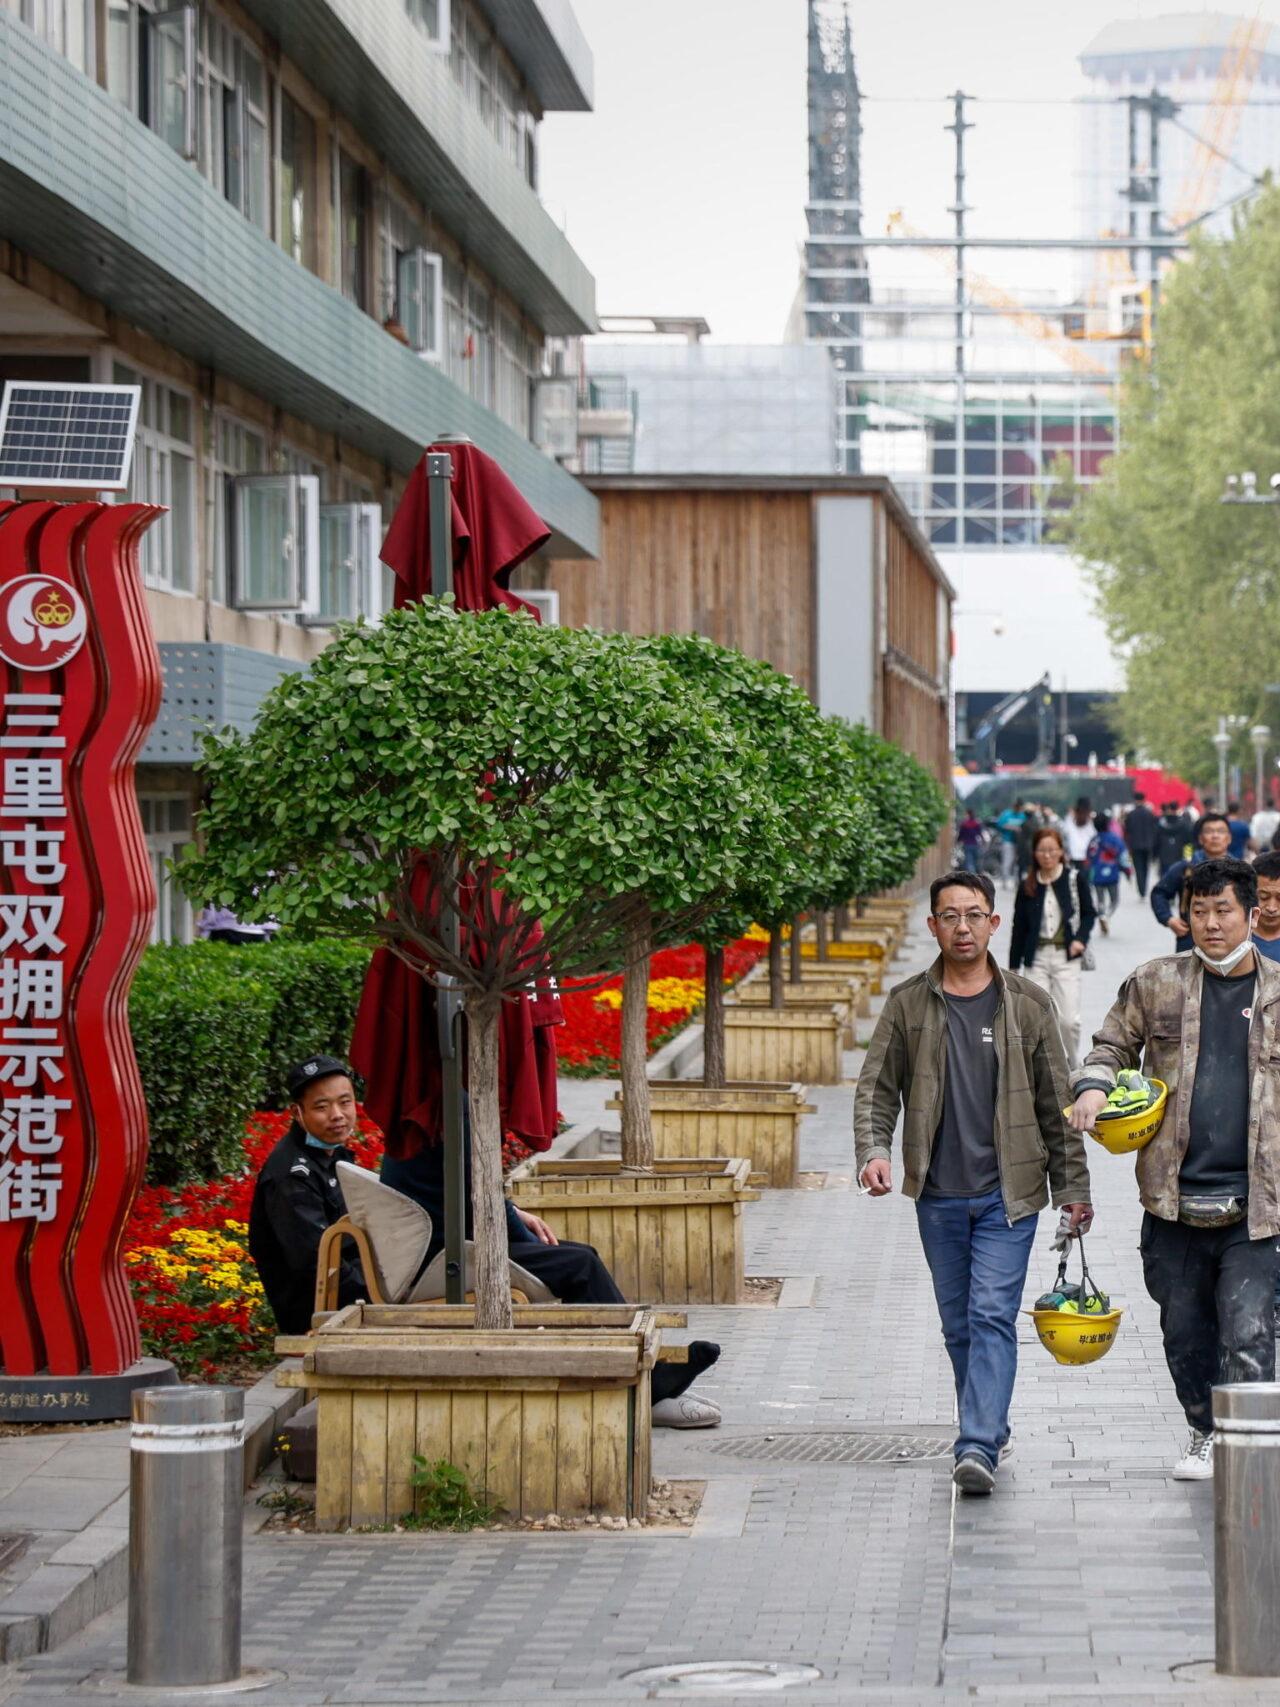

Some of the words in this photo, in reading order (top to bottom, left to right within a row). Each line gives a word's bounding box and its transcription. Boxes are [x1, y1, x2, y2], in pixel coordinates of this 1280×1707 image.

[0, 693, 72, 1222] 三里屯双拥示范街
